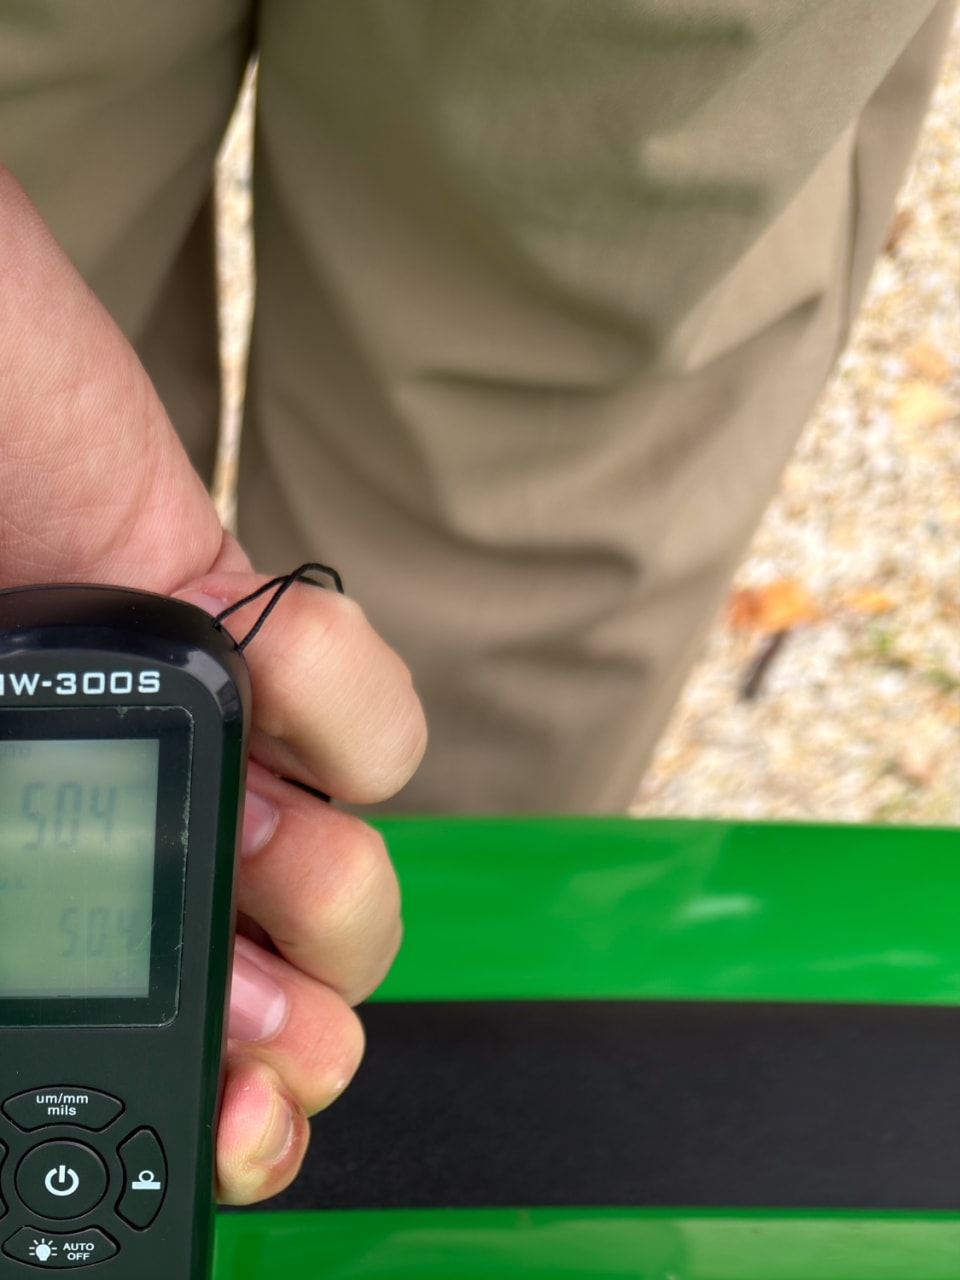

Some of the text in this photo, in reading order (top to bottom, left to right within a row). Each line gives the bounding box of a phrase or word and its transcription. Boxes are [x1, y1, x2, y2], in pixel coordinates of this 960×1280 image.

[21, 780, 117, 850] 504
[59, 905, 140, 957] 504
[36, 1093, 89, 1106] um/mm
[47, 1104, 77, 1116] mils
[63, 1242, 95, 1252] AUTO
[67, 1251, 91, 1261] OFF
